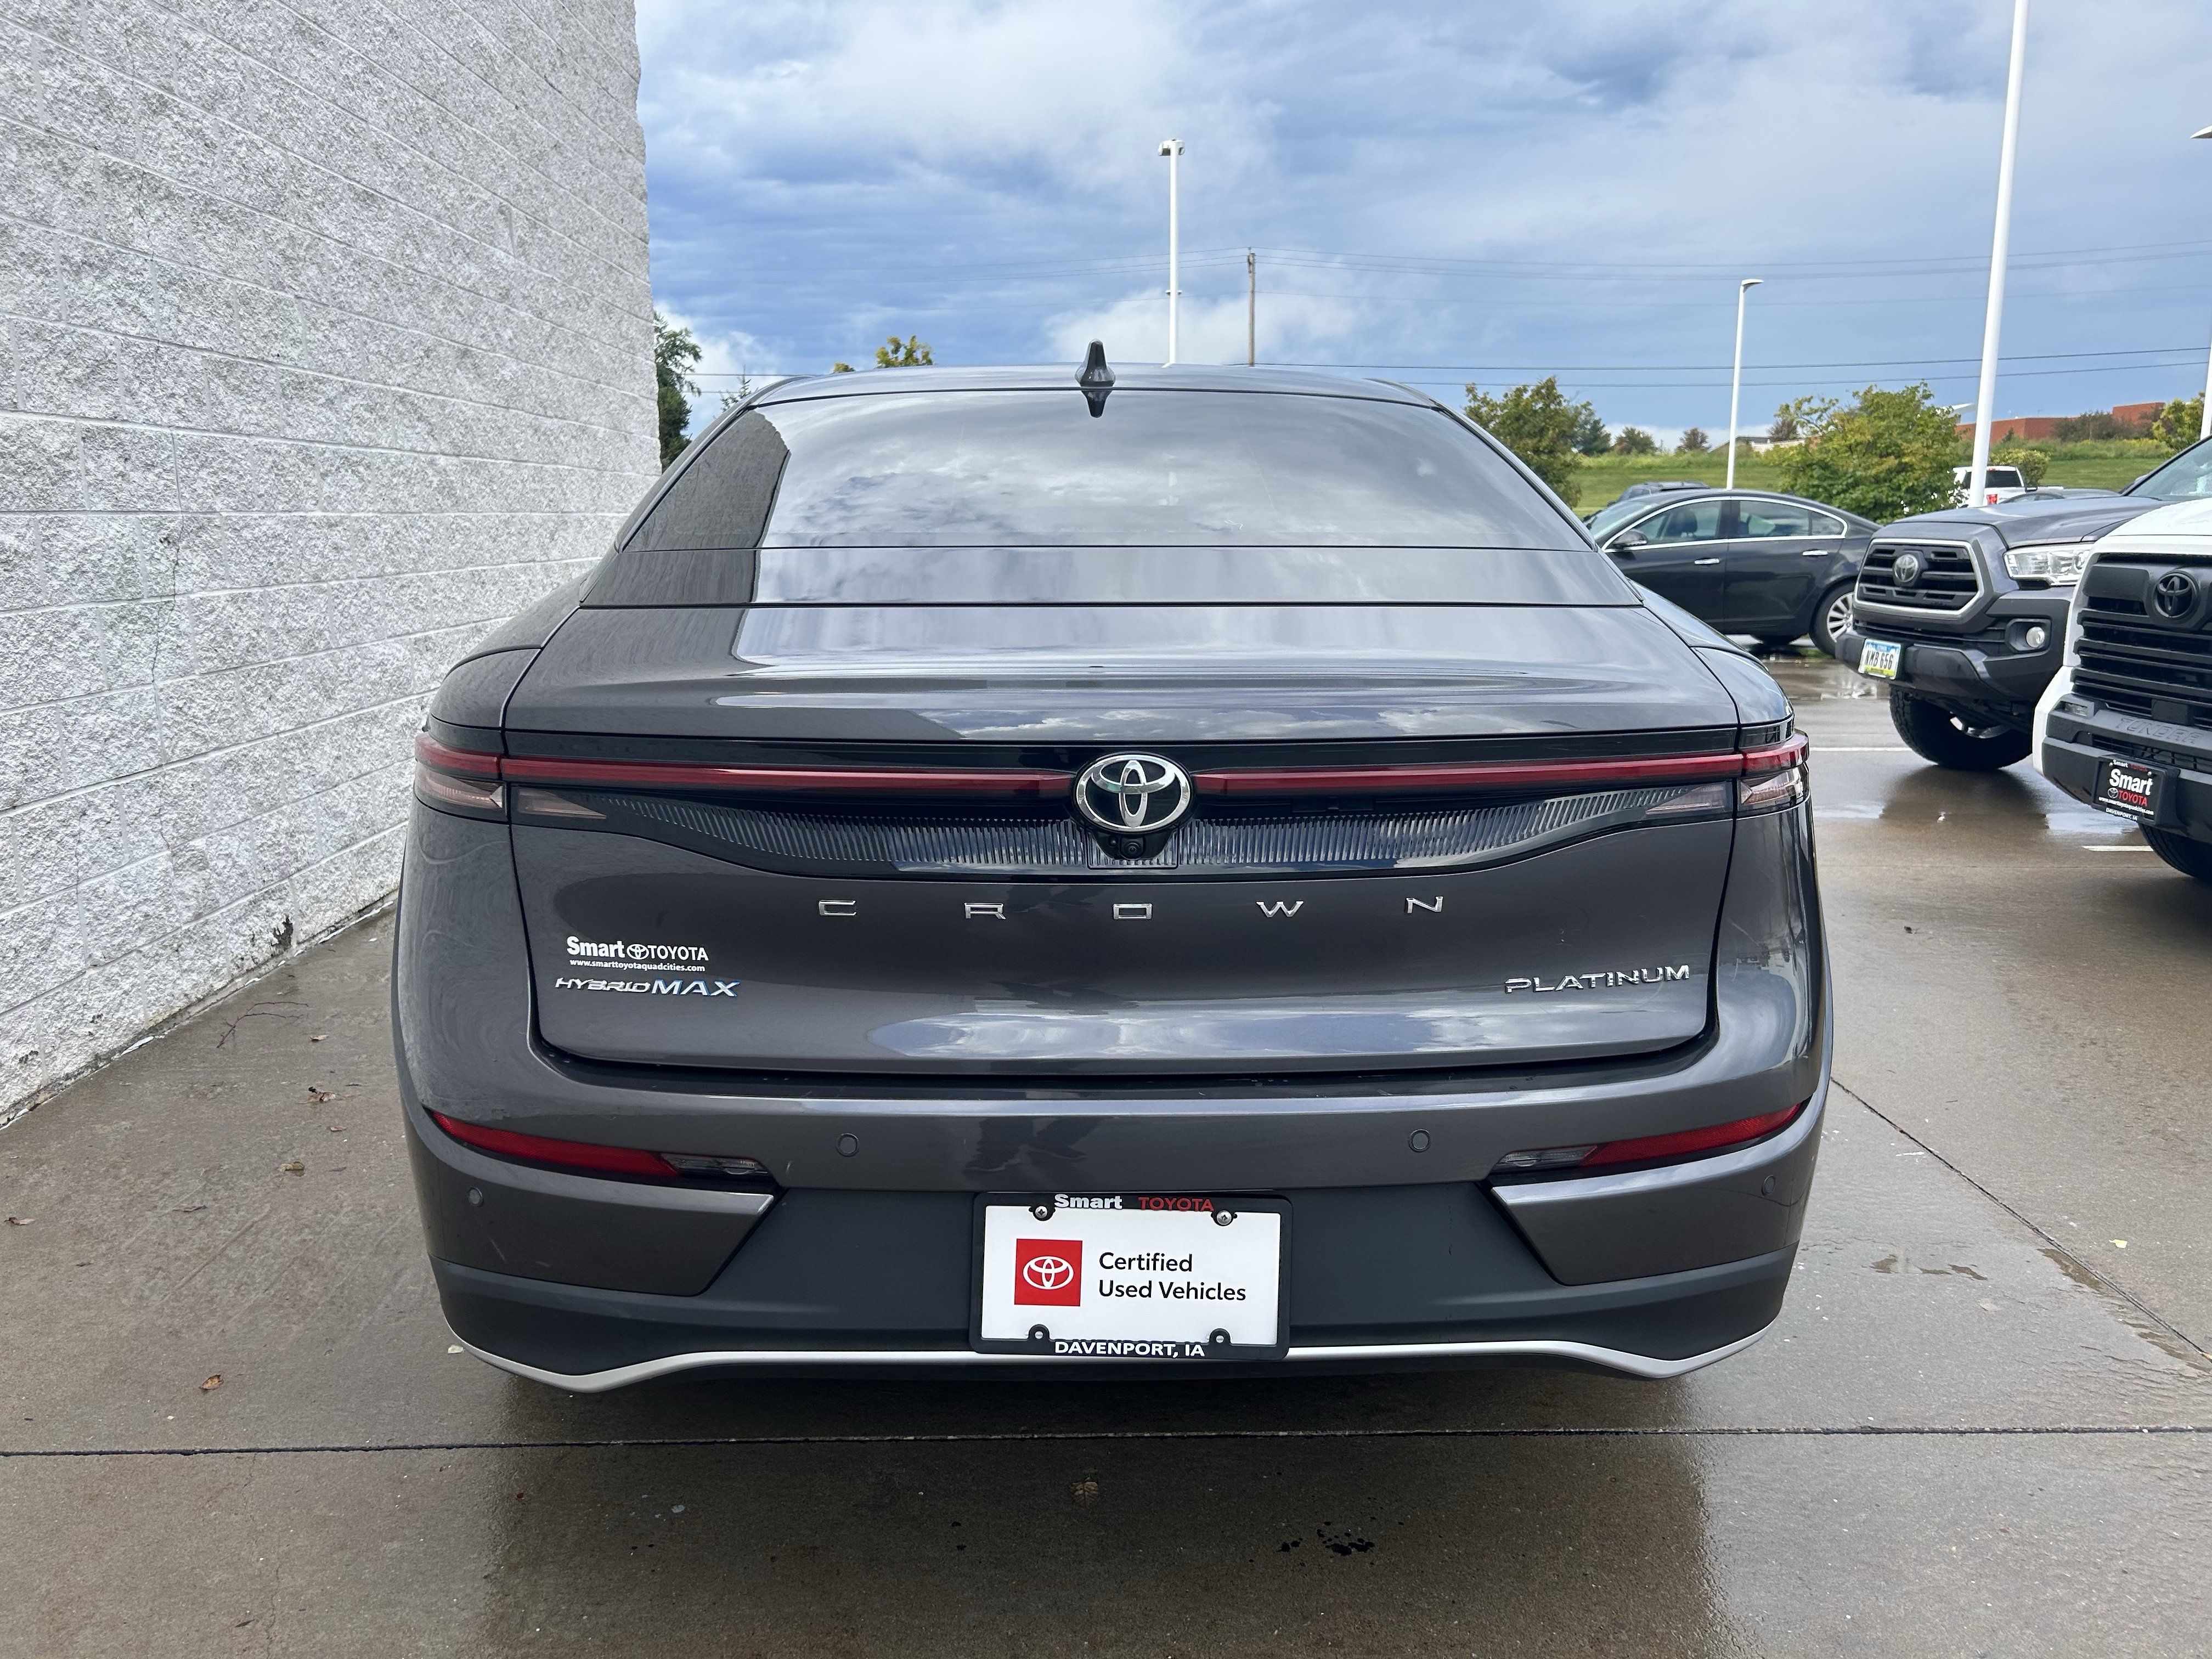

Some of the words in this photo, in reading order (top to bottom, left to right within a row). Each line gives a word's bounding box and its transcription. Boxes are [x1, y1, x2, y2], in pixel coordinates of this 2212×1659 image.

[1880, 652, 1894, 670] 656
[2115, 718, 2204, 744] TUNDRA
[2113, 759, 2128, 768] Smart
[2109, 768, 2153, 795] Smart
[2119, 790, 2148, 806] TOYOTA
[819, 895, 1444, 920] CROWN
[566, 936, 625, 958] Smart
[648, 945, 709, 961] TOYOTA
[569, 960, 706, 972] www.smarttoyotaquadcities.com
[651, 979, 741, 997] MAX
[1505, 964, 1690, 994] PLATINUM
[1054, 1193, 1123, 1210] Smart
[1137, 1196, 1215, 1212] TOYOTA
[1099, 1252, 1193, 1272] Certified
[1099, 1280, 1152, 1299] Used
[1159, 1282, 1247, 1301] Vehicles
[1055, 1340, 1180, 1358] DAVENPORT,
[1185, 1344, 1205, 1357] IA
